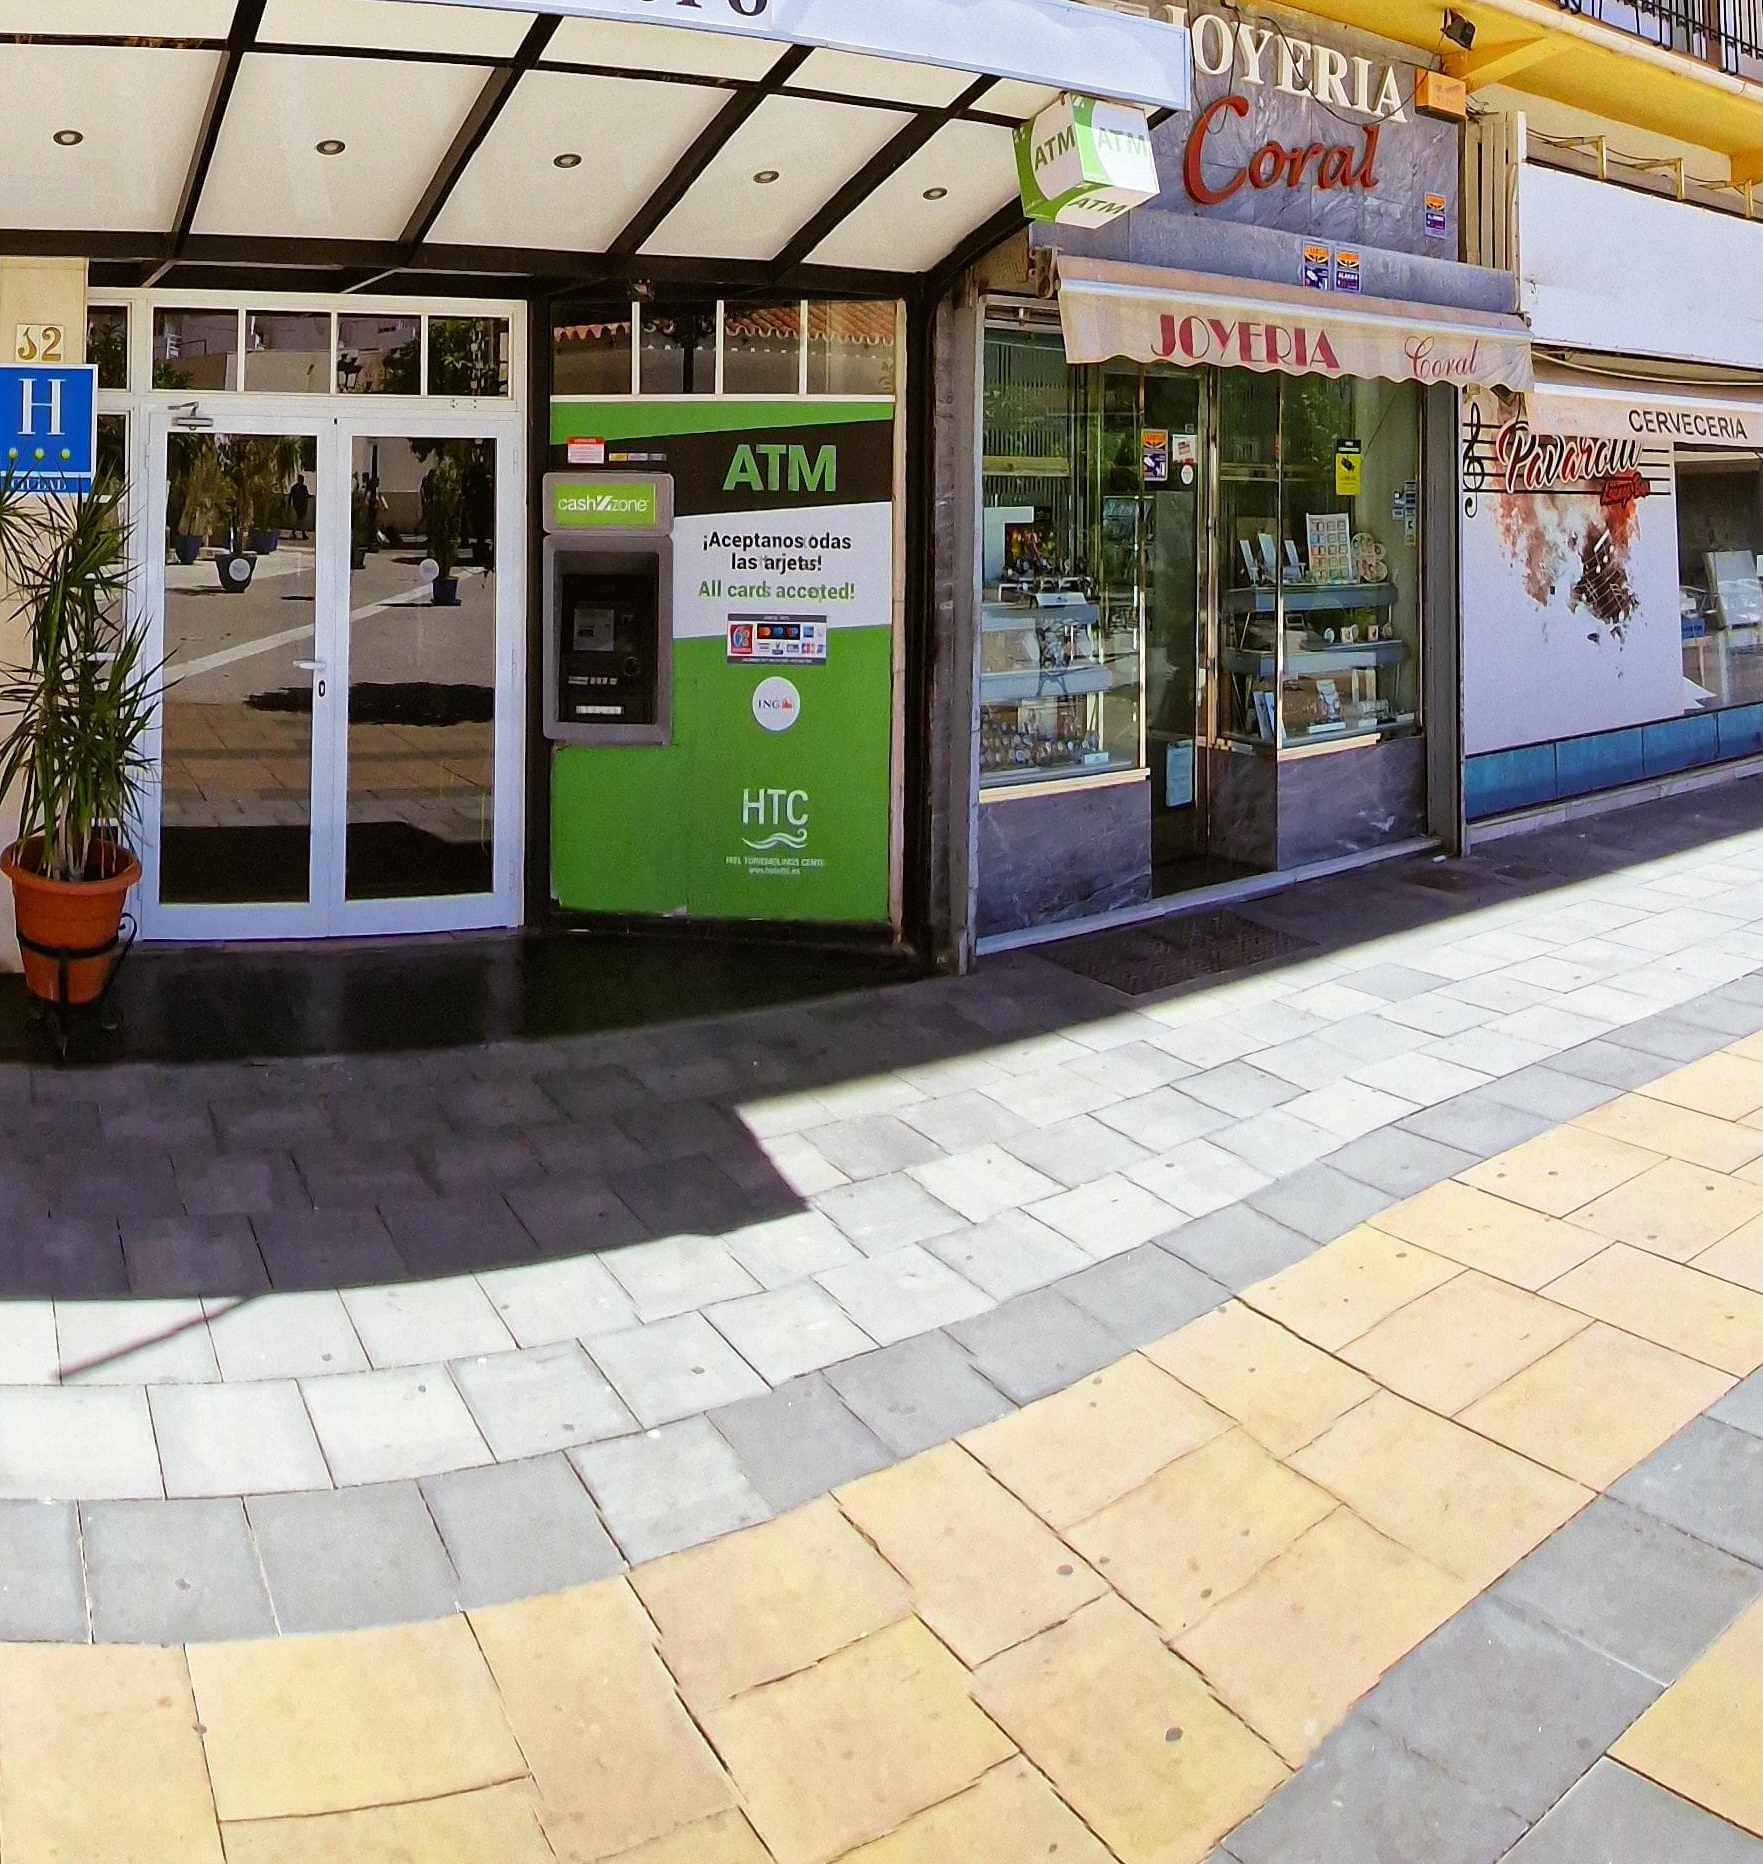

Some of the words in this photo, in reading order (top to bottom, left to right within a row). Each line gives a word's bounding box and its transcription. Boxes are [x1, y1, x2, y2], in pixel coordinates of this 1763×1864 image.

[1165, 4, 1408, 124] OYERIA
[1034, 125, 1076, 171] ATM
[1098, 127, 1148, 156] ATM
[1182, 94, 1380, 206] Coral
[1066, 197, 1129, 215] ATM
[1150, 313, 1342, 370] JOYERIA
[1404, 335, 1479, 379] Coral
[16, 378, 67, 436] H
[1628, 409, 1749, 440] CERVECERIA
[722, 443, 837, 492] ATM
[730, 551, 758, 570] las
[698, 579, 722, 597] All
[758, 699, 780, 710] ING
[742, 787, 809, 826] HTC
